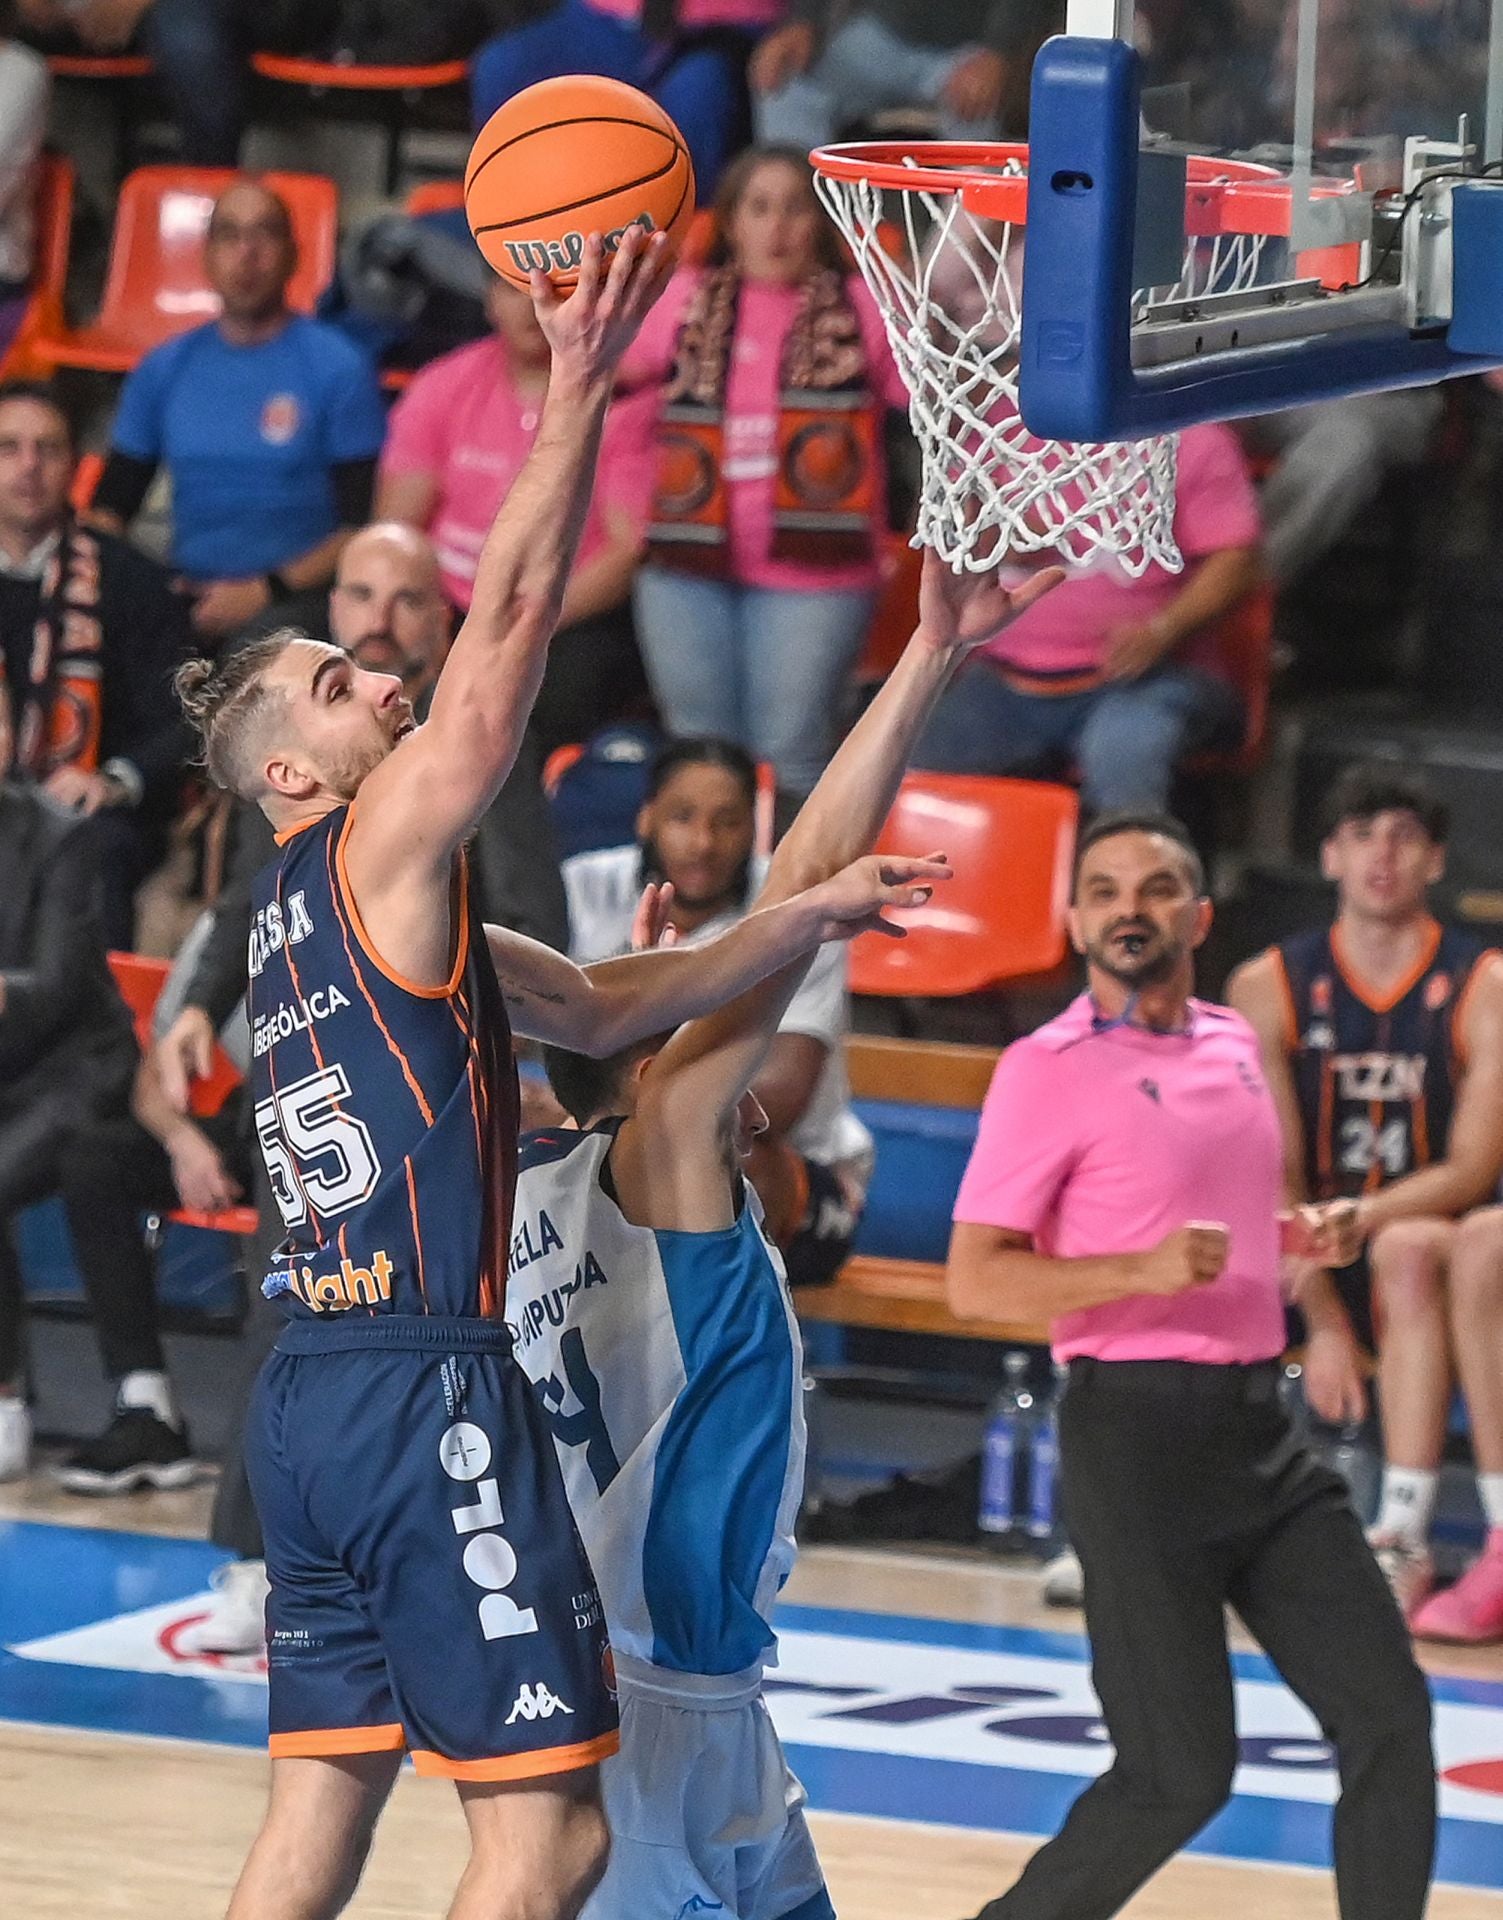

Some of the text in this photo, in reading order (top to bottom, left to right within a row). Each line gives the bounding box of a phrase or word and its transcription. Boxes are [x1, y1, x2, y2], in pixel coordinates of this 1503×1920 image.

[502, 211, 656, 276] Wilo
[254, 1062, 382, 1228] 55
[438, 1421, 539, 1641] POLO
